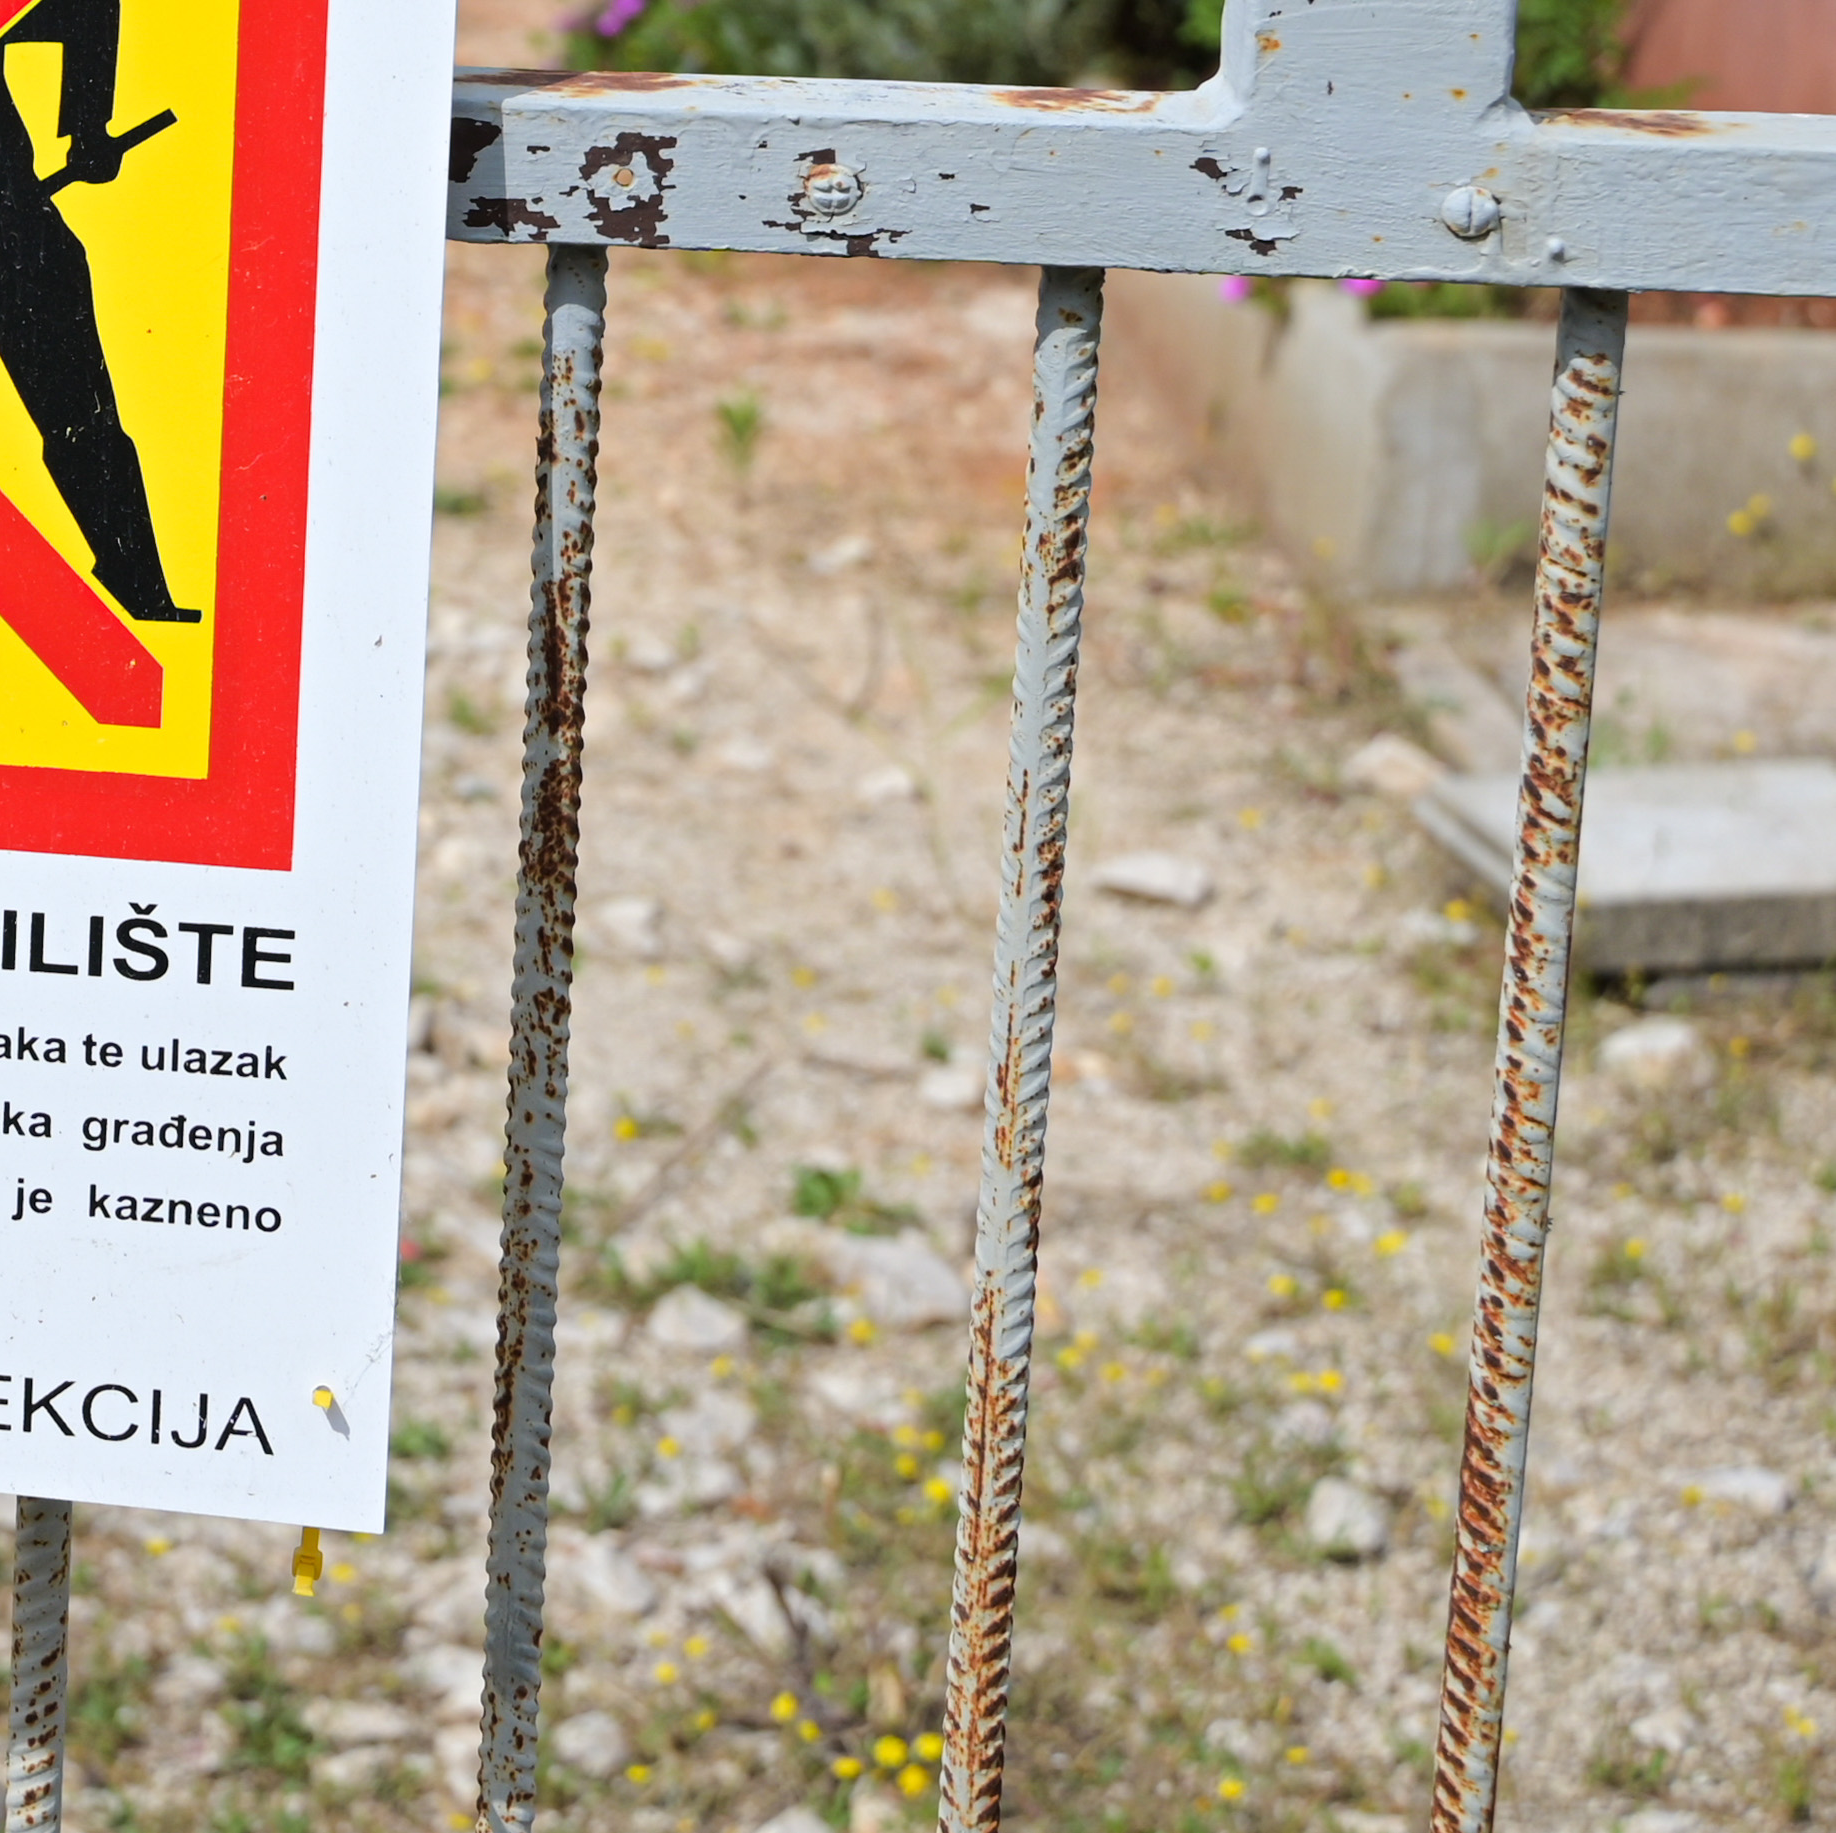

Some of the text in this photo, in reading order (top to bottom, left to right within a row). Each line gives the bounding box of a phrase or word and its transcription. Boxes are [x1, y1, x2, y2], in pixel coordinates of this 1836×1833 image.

[82, 1033, 124, 1068] te
[141, 1038, 287, 1081] ulazak
[82, 1114, 284, 1164] građenja
[11, 1177, 53, 1221] je
[89, 1183, 282, 1233] kazneno
